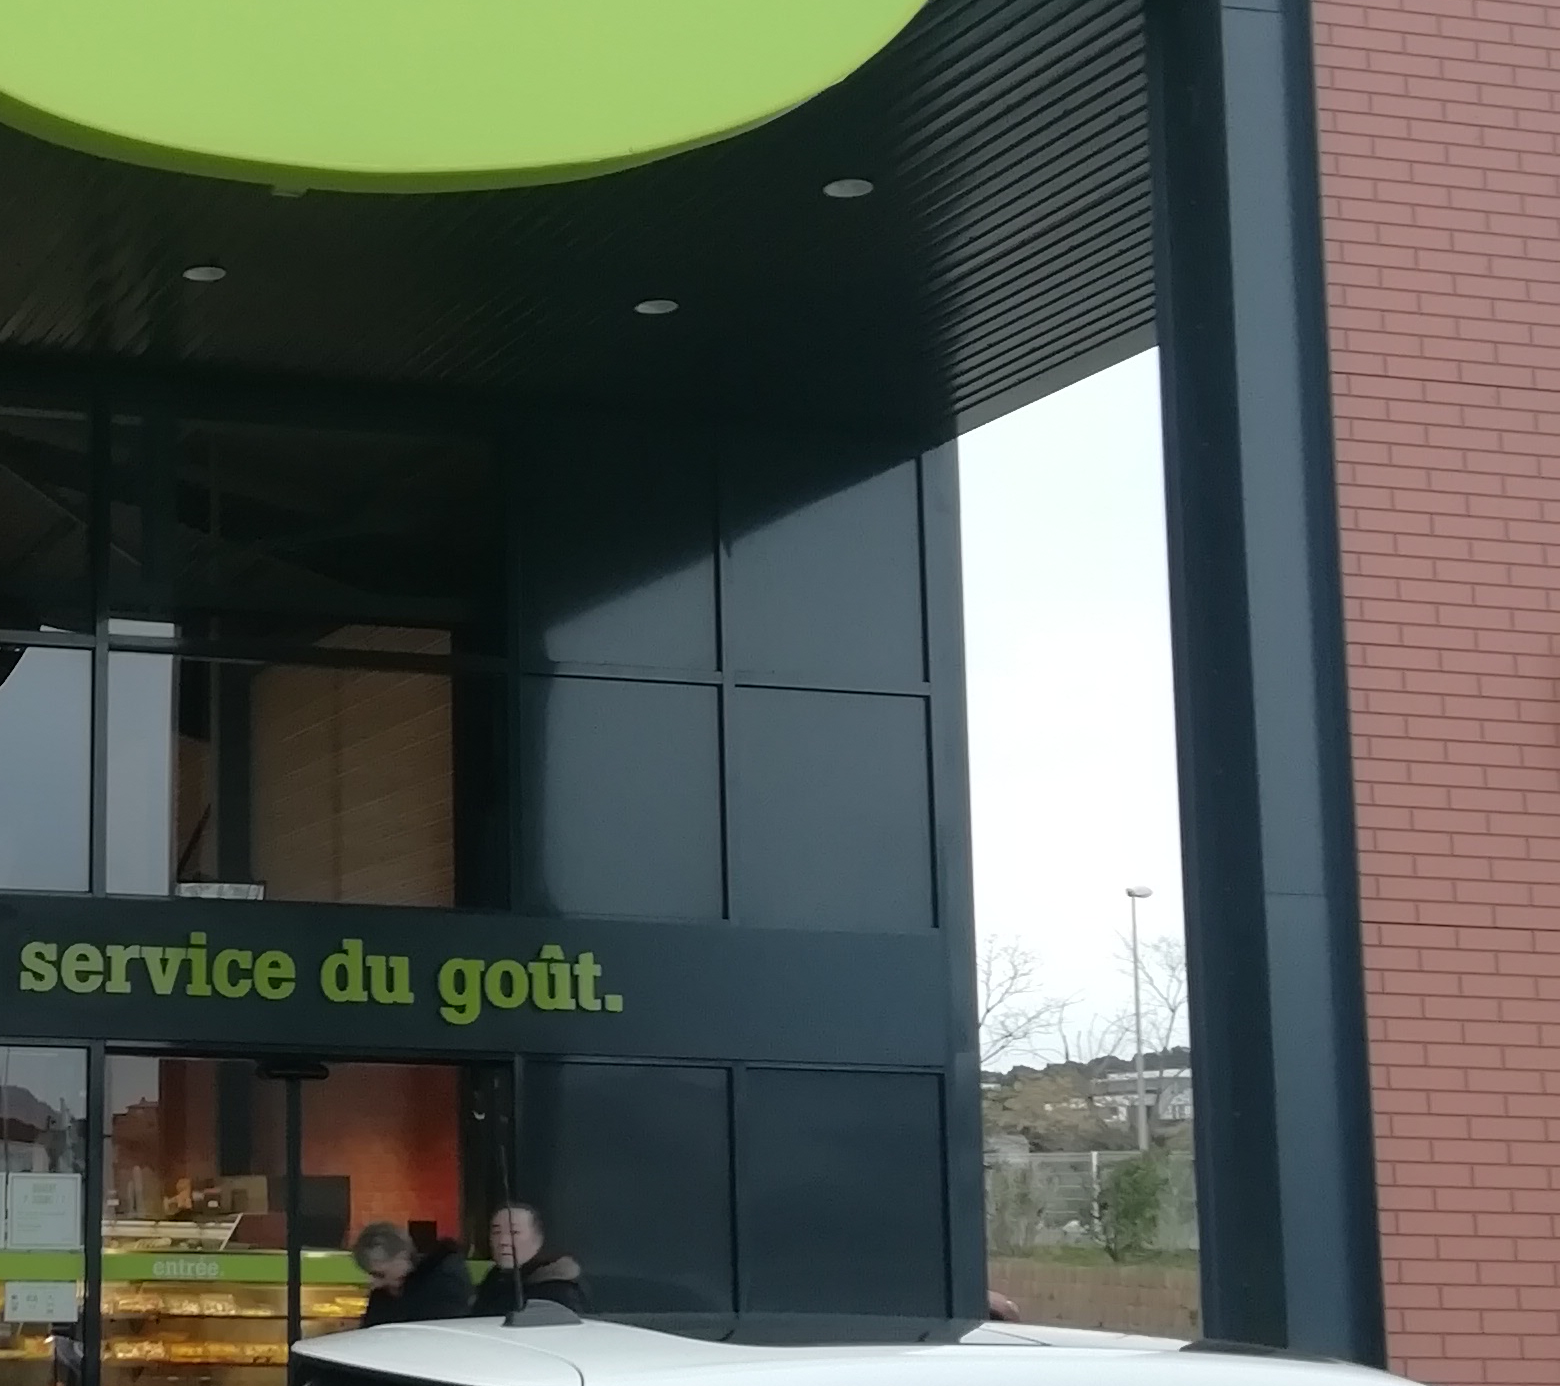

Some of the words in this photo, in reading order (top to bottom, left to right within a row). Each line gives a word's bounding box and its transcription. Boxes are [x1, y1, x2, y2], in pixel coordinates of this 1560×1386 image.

[20, 931, 297, 1000] service
[321, 938, 415, 1004] du
[439, 943, 624, 1026] goût.
